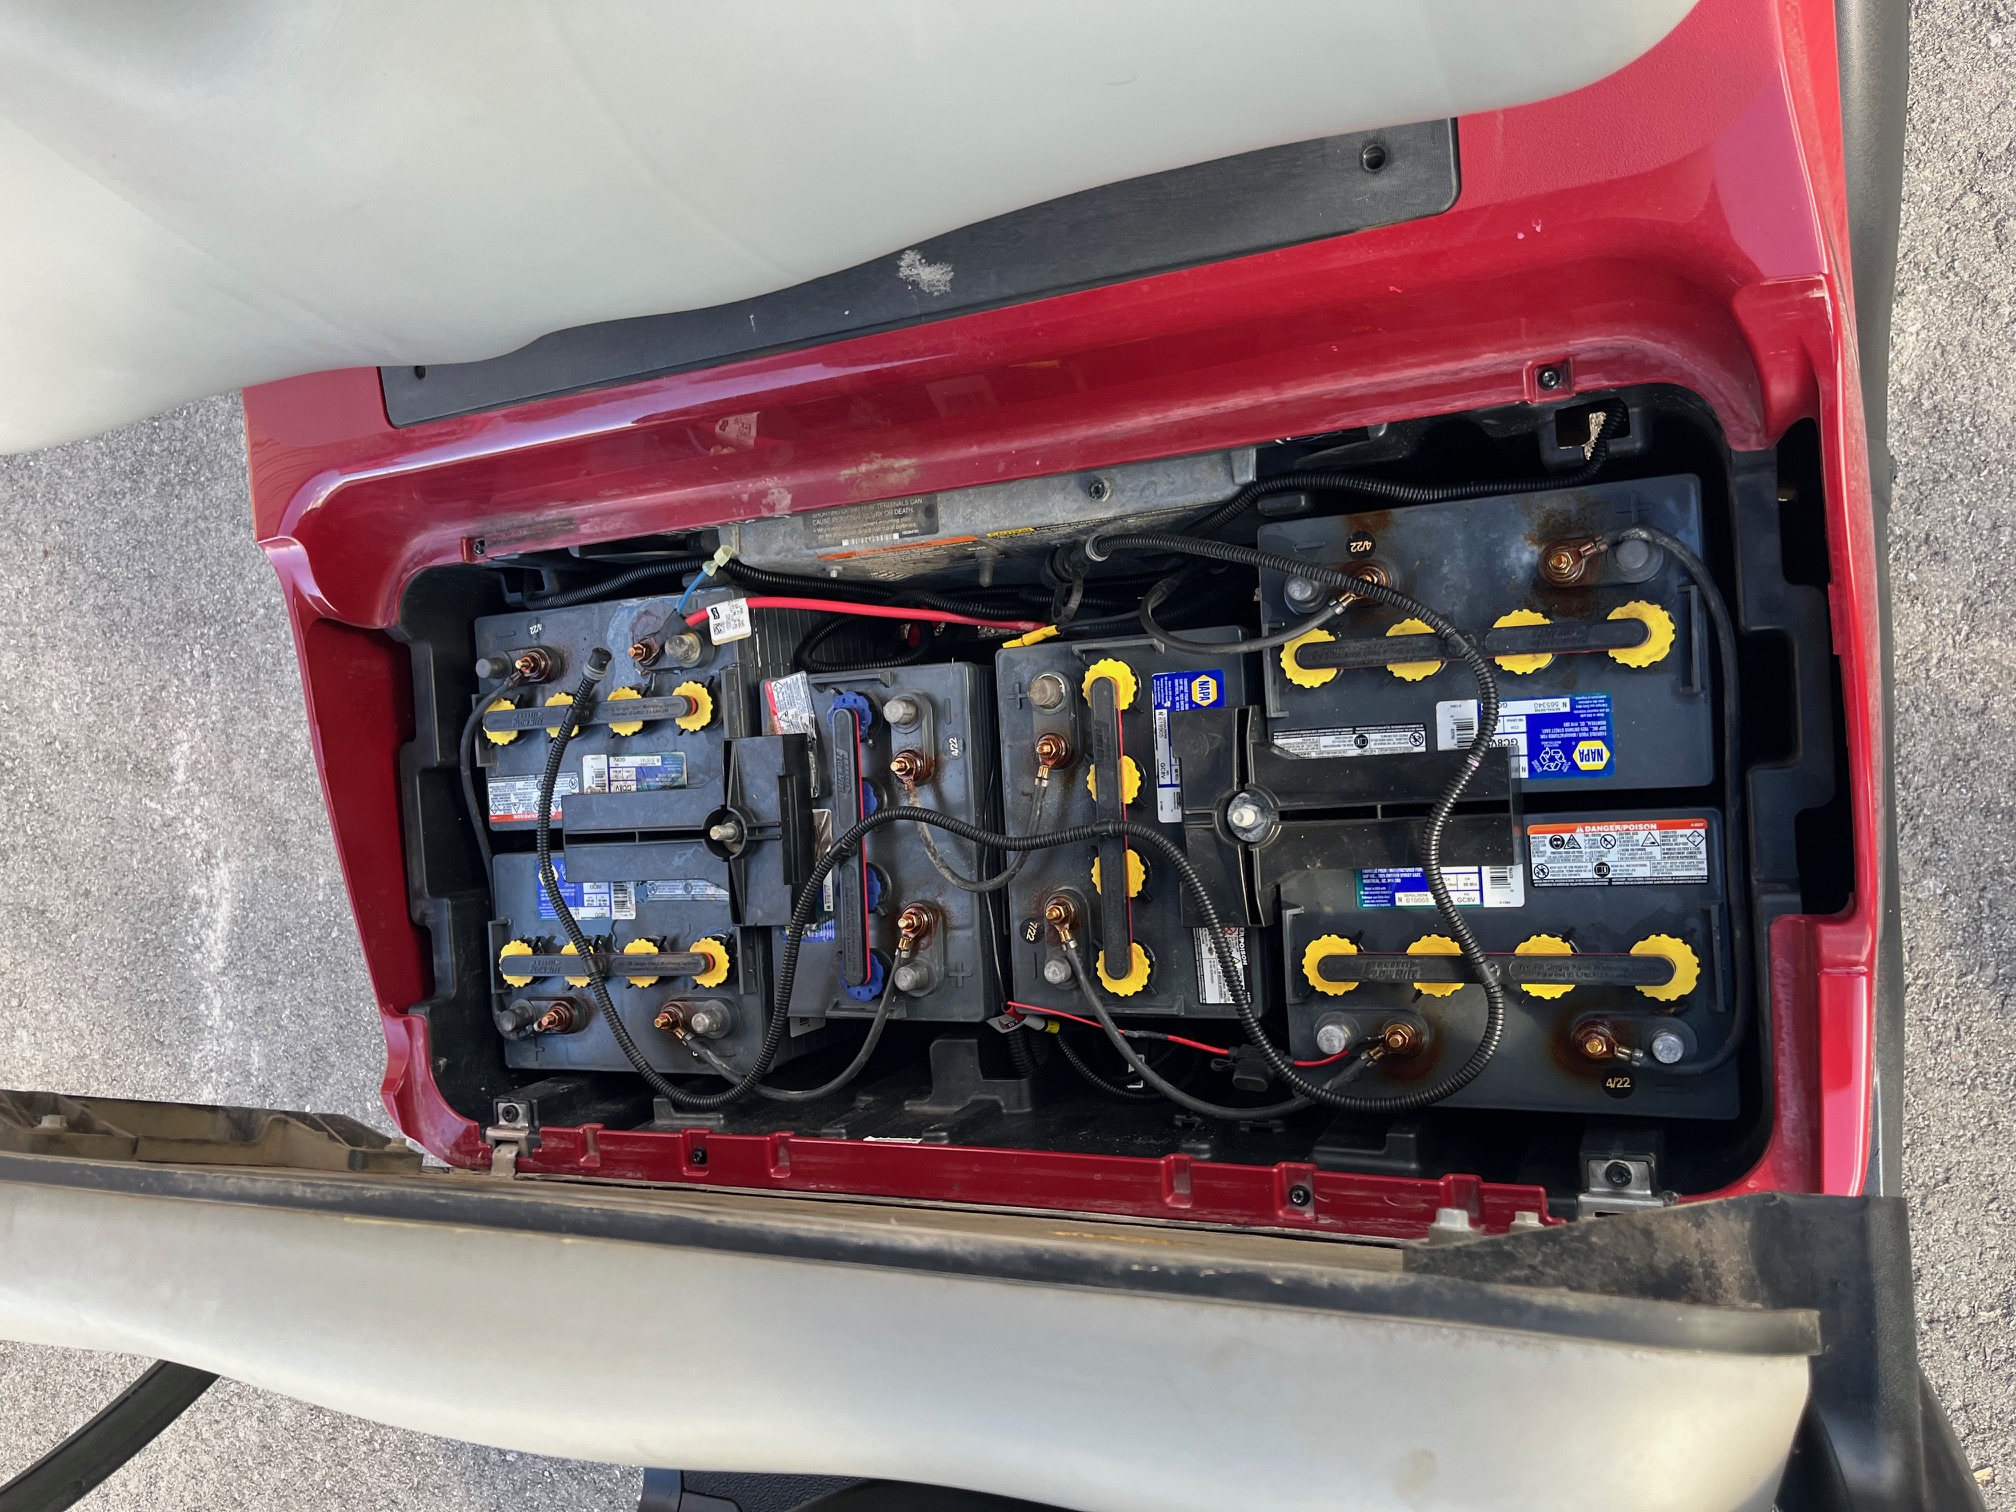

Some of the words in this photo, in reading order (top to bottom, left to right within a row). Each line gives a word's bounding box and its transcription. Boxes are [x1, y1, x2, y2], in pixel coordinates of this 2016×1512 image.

[1350, 540, 1373, 553] 4/22
[1198, 680, 1211, 702] NAPA
[1533, 701, 1559, 709] 565340
[949, 737, 959, 757] 4/22
[1578, 748, 1604, 763] NAPA
[1584, 822, 1657, 833] DANGER/POISON
[1456, 896, 1476, 904] GC8V
[1026, 921, 1038, 942] 7/22
[1238, 927, 1248, 966] ER/POISON
[1605, 1077, 1631, 1089] 4/22
